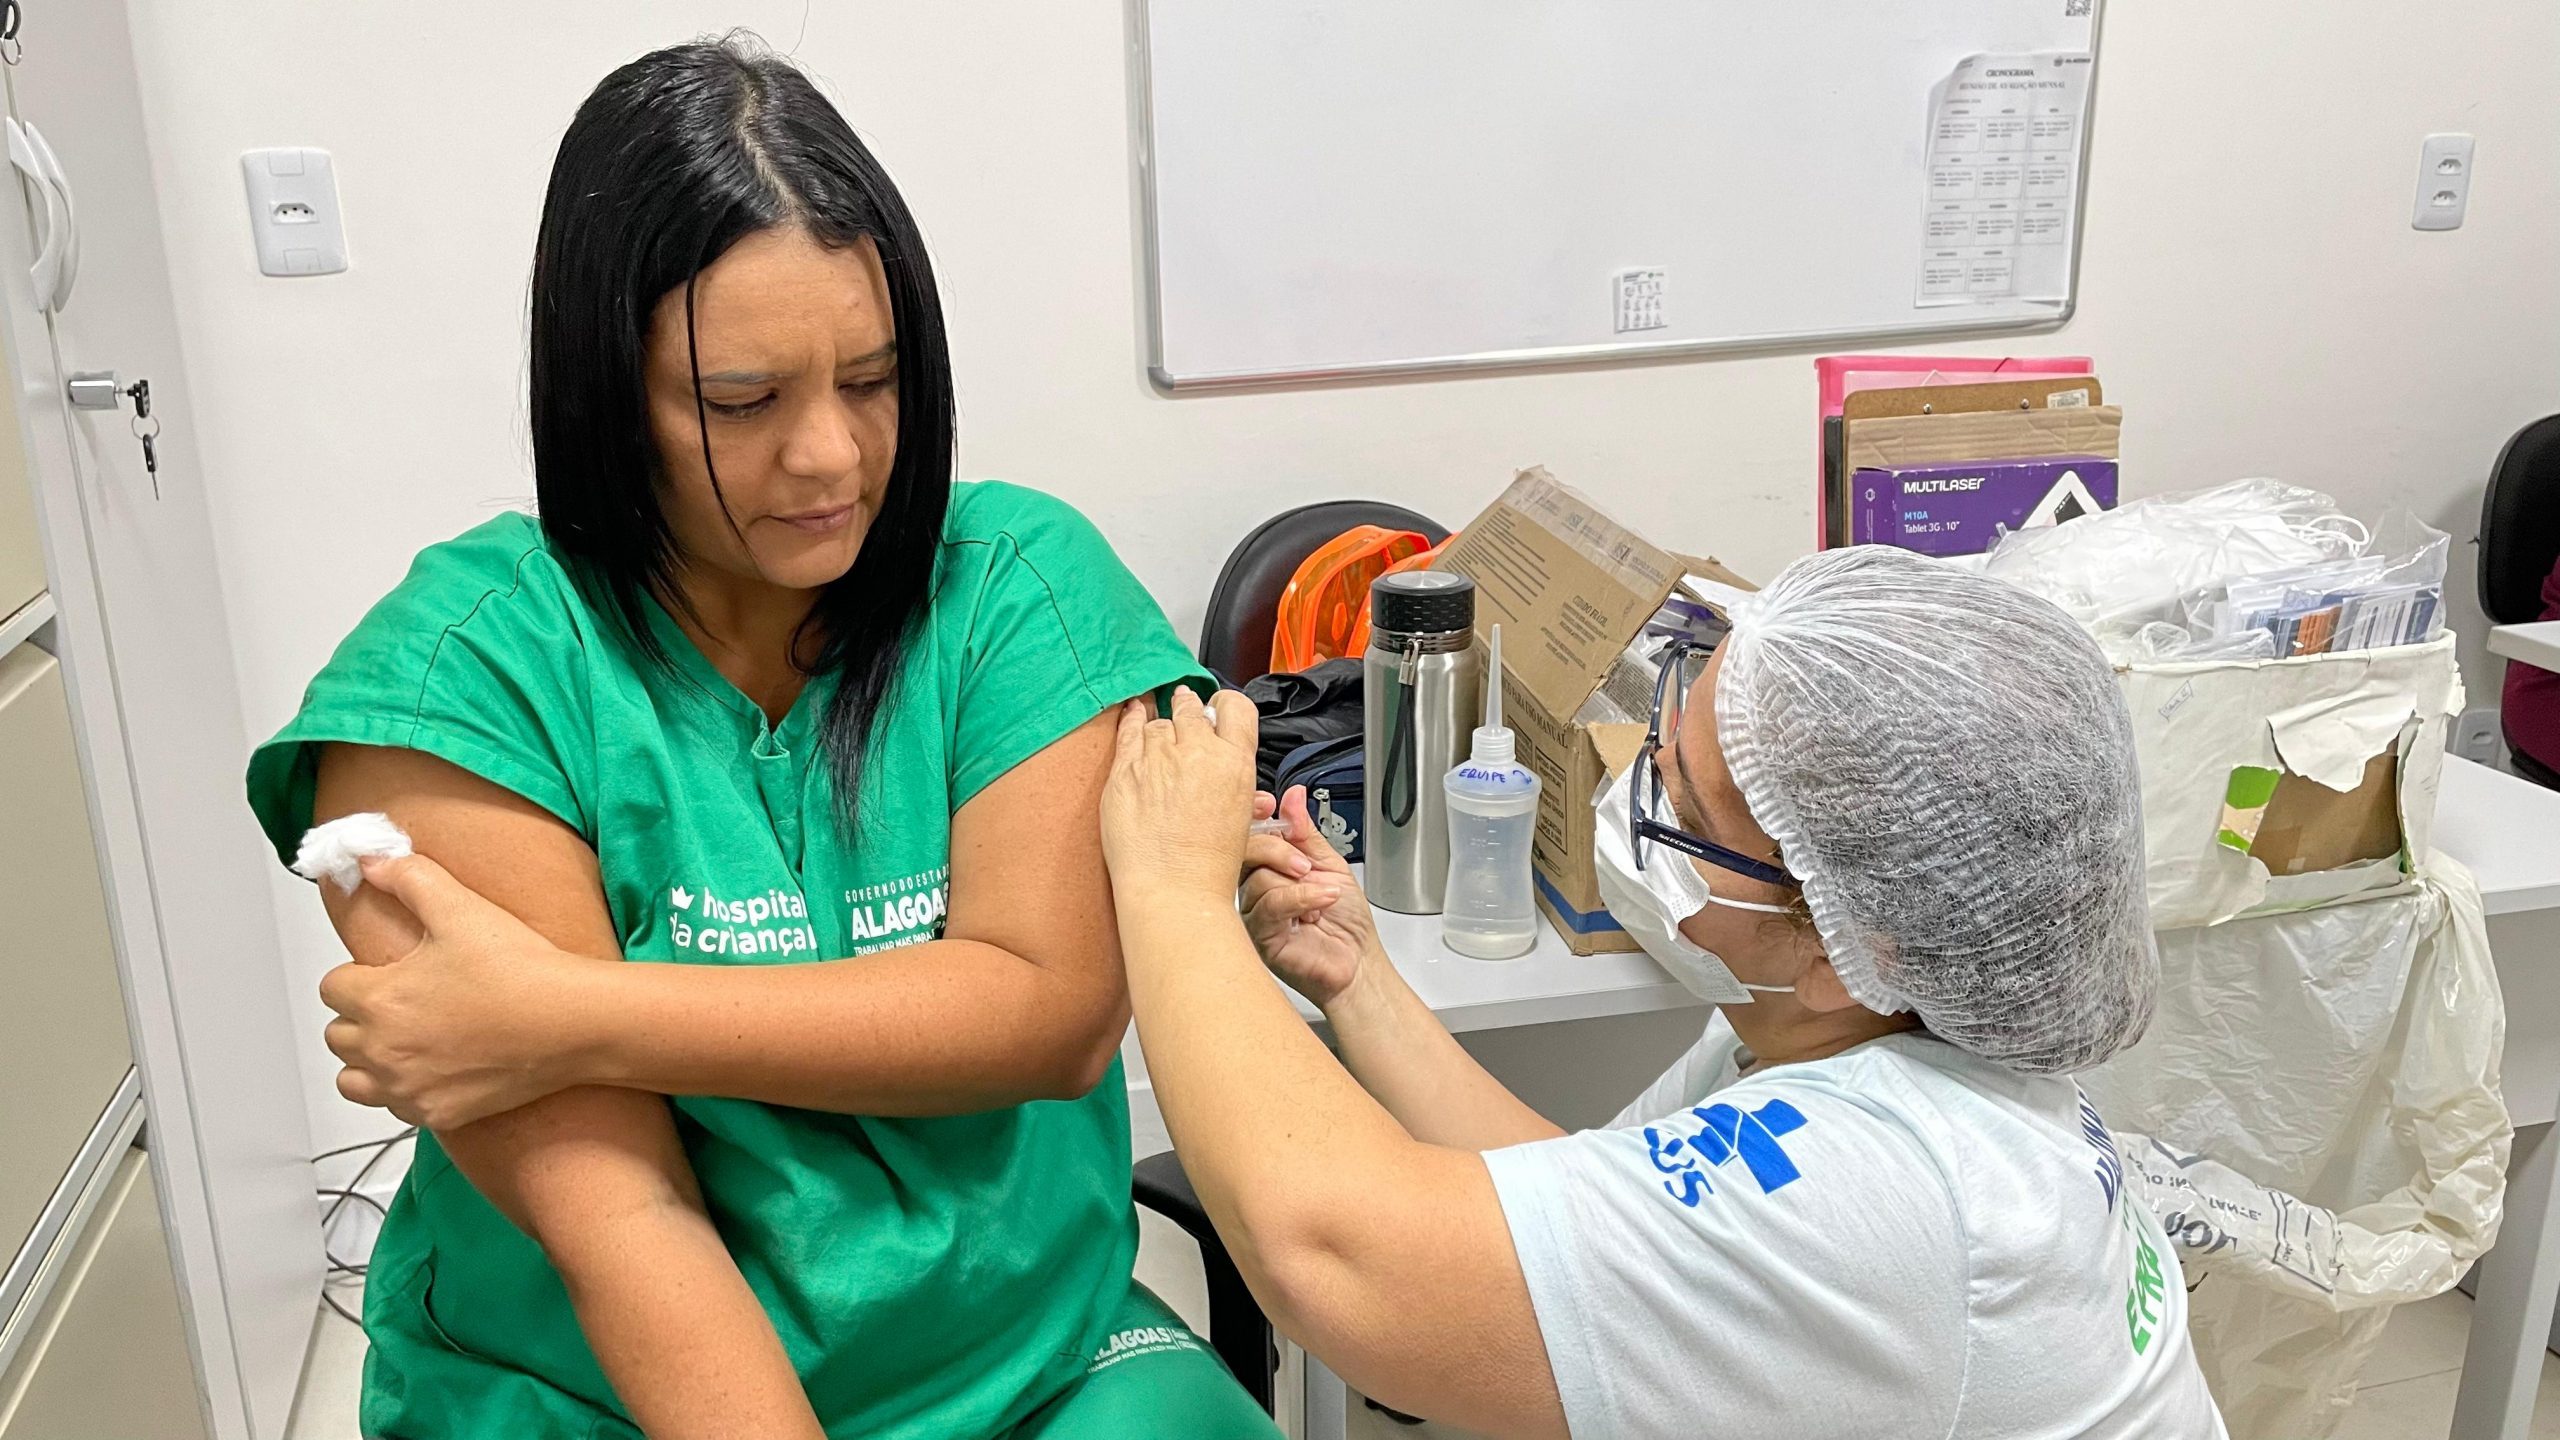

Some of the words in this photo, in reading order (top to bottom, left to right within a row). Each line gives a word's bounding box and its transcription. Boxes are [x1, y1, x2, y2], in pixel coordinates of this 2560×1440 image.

[1985, 69, 2034, 77] CRONOGRAMA
[1904, 511, 1928, 520] M10A
[1904, 523, 1927, 533] Tablet
[1536, 712, 1568, 749] MANUAL
[1458, 768, 1506, 783] EQUIPE
[845, 881, 897, 904] GOVERNO
[899, 876, 914, 892] DO
